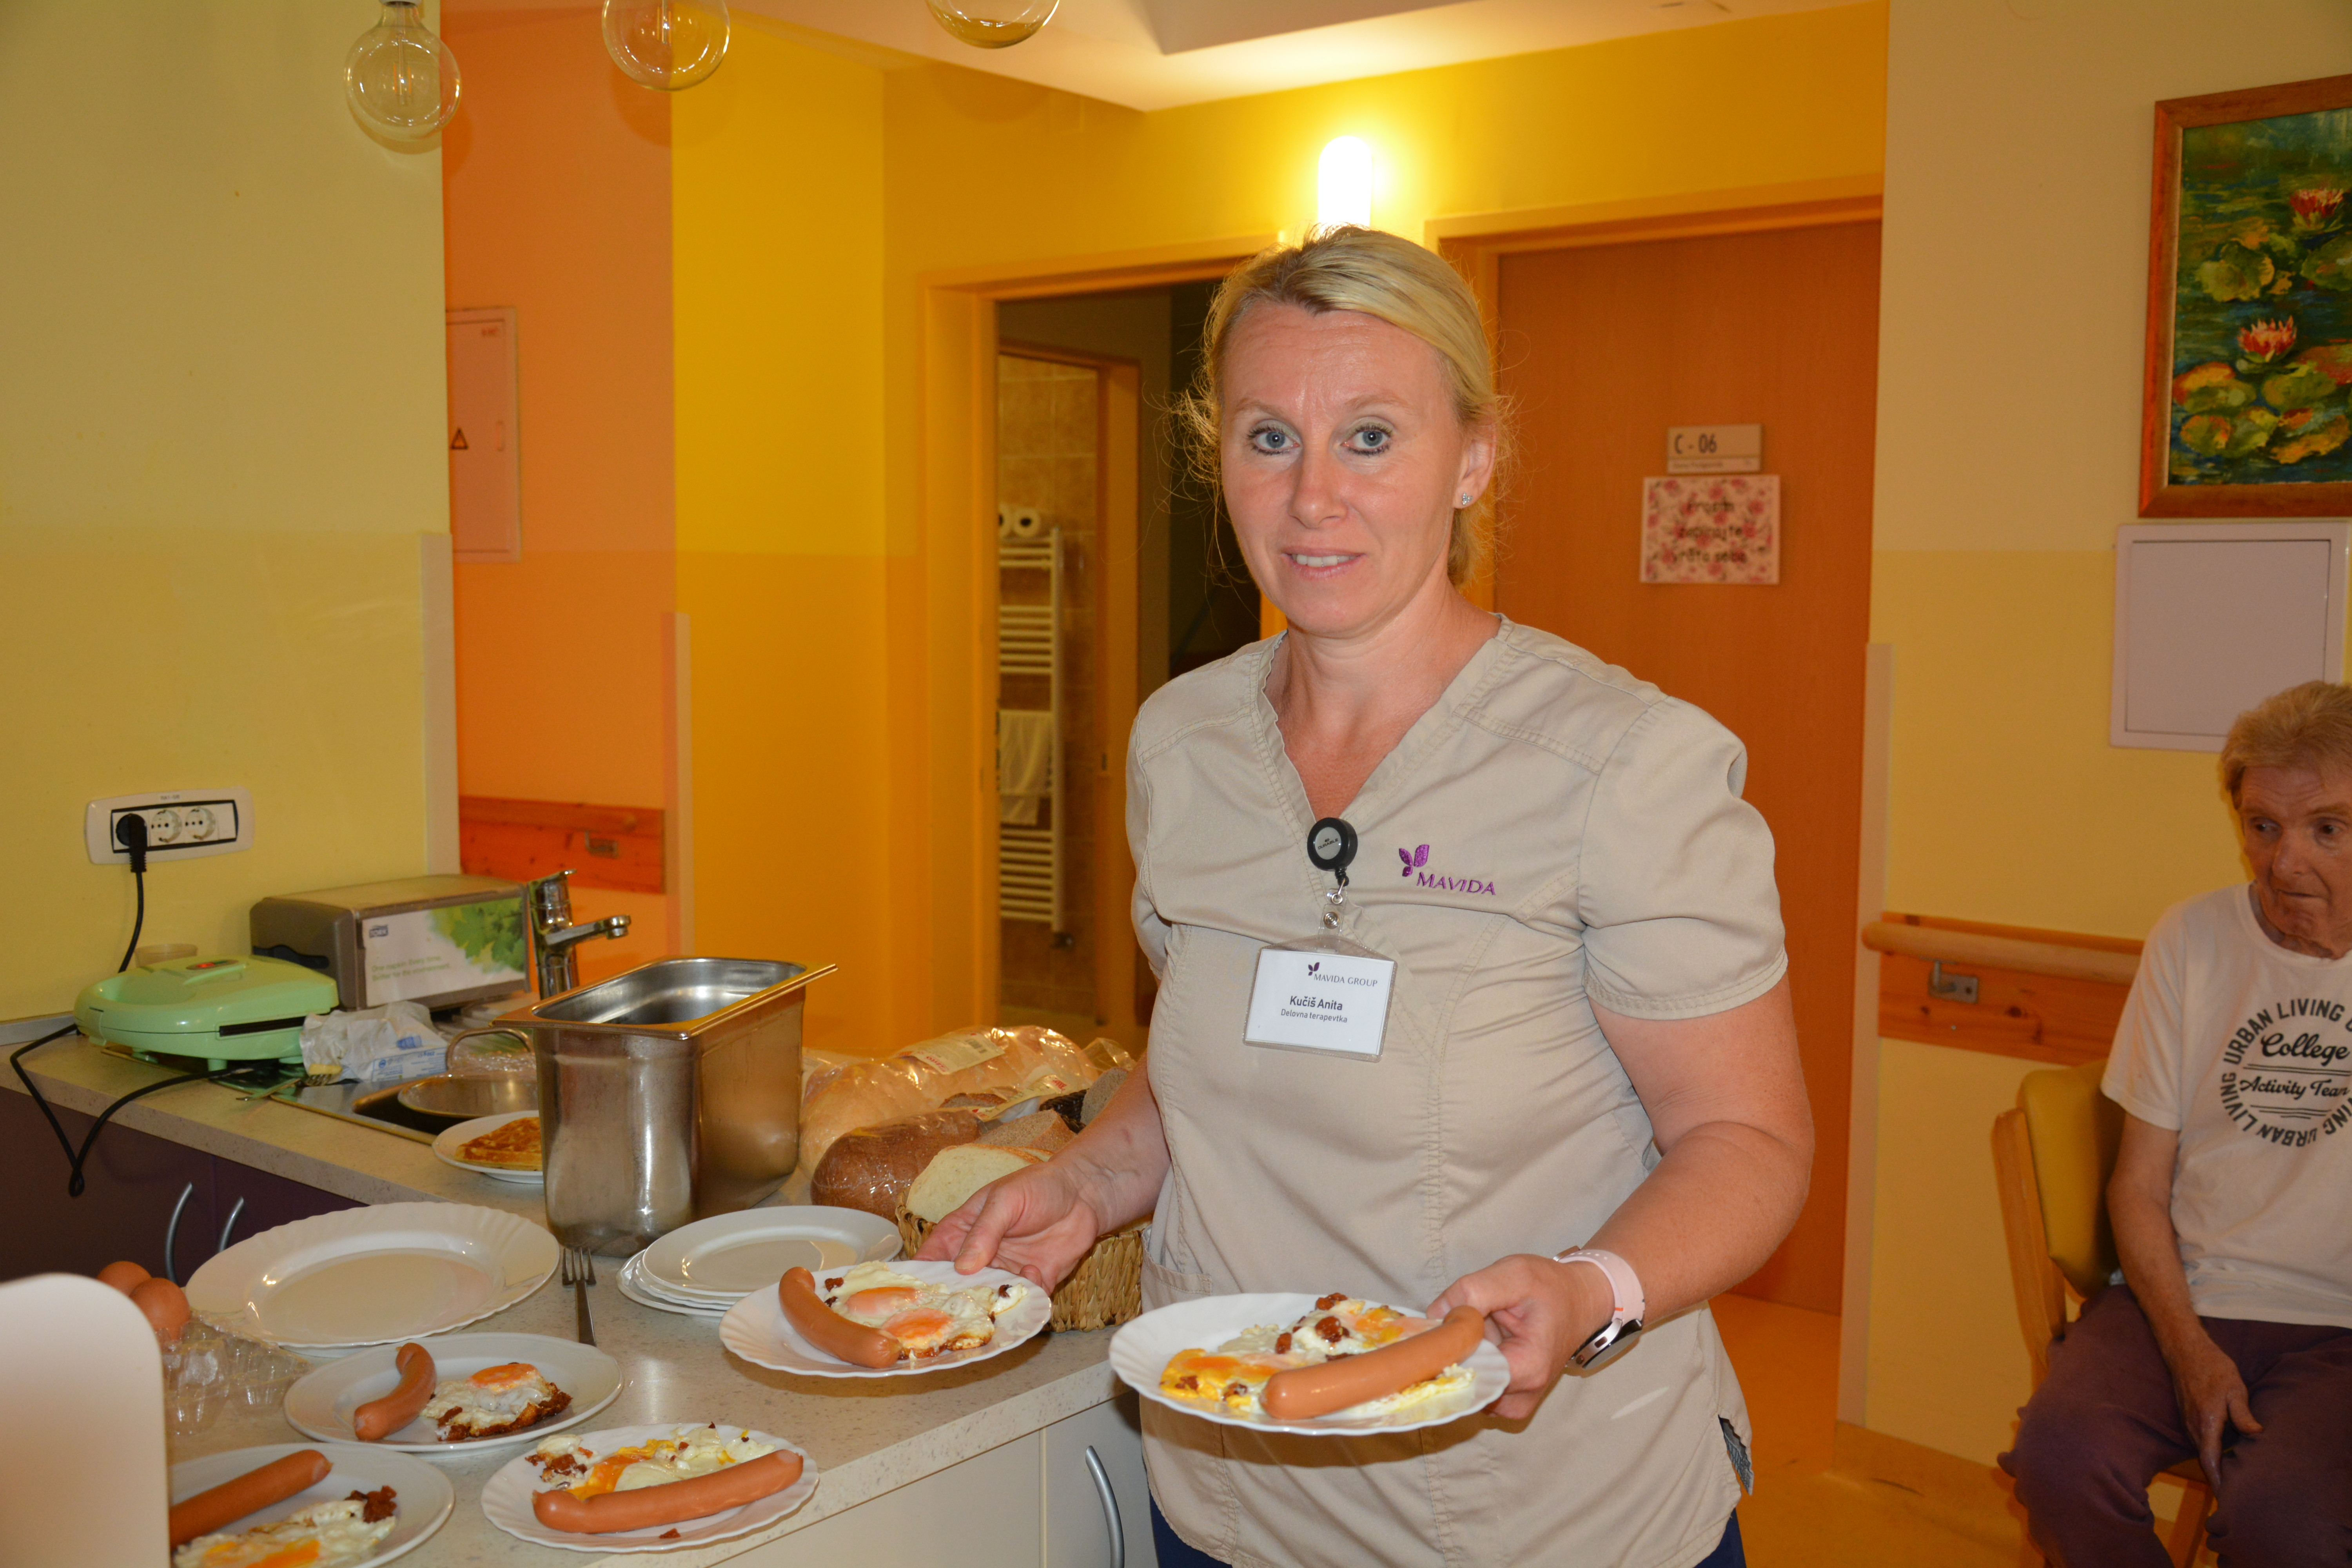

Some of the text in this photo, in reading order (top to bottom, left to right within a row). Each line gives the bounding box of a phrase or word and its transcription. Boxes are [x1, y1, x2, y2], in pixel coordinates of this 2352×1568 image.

[1674, 433, 1684, 454] C
[1698, 433, 1718, 454] 06
[1317, 837, 1339, 850] DURABLE
[1416, 871, 1496, 896] MAVIDA
[1313, 973, 1378, 987] MAVIDA GROUP
[1289, 995, 1343, 1011] Kučiš Anita
[1280, 1009, 1348, 1023] Delovna terapevtka
[2223, 998, 2345, 1065] URBAN LIVING
[2260, 1033, 2350, 1067] College
[2239, 1076, 2307, 1100] Activity
[2220, 1072, 2258, 1132] LIVING
